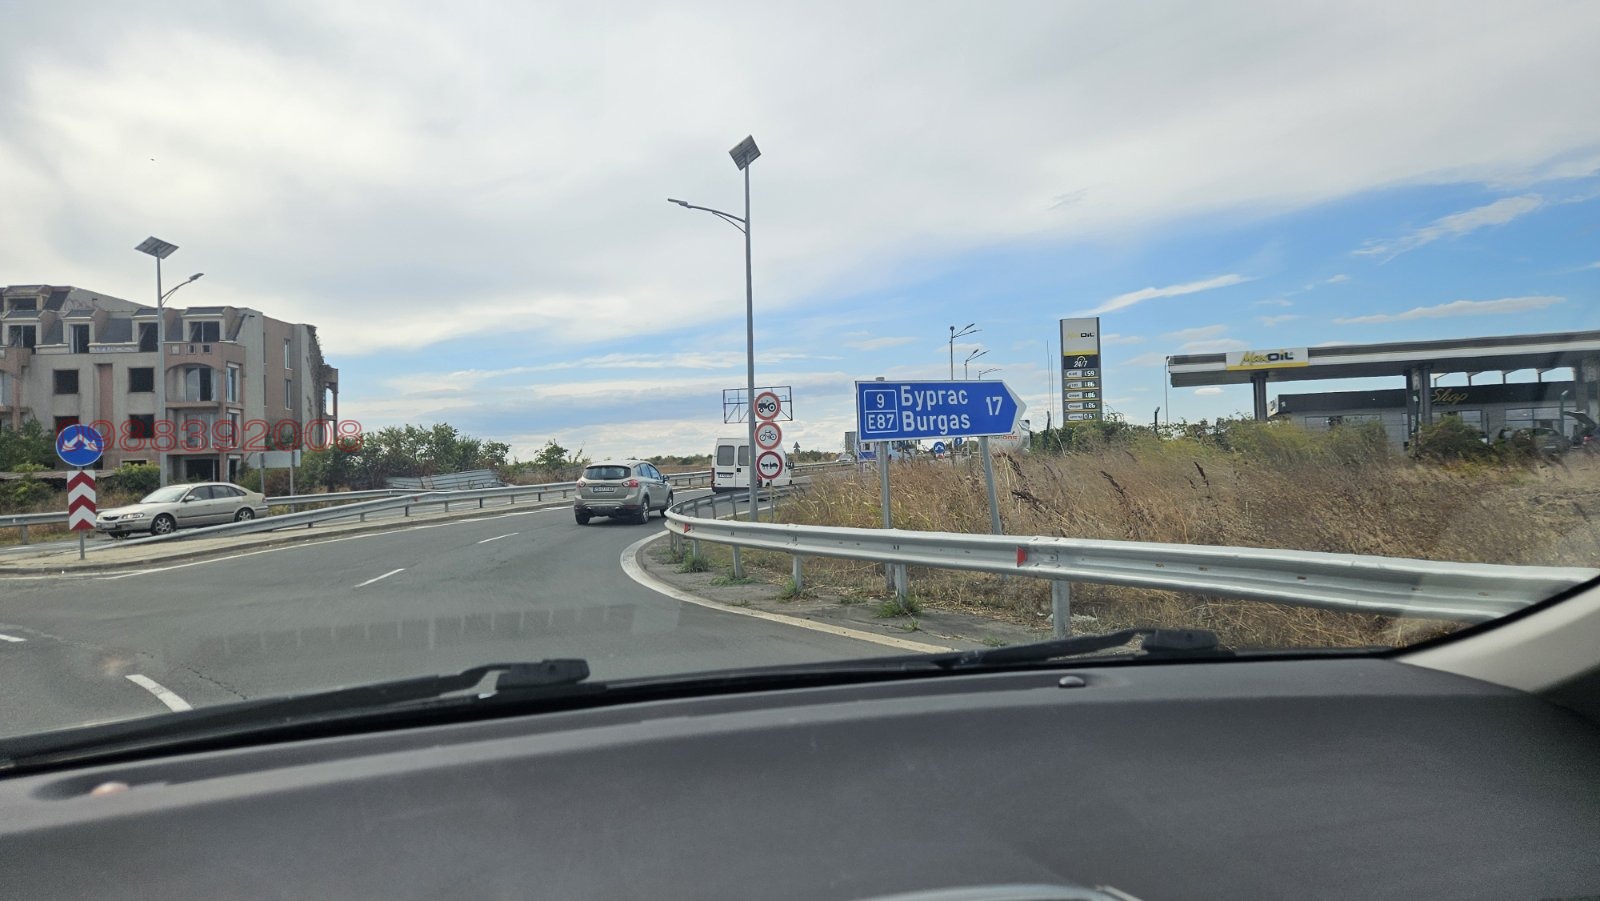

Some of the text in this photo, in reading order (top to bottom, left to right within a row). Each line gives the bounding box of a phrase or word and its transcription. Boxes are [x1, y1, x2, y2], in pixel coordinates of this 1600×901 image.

[876, 393, 885, 409] 9
[900, 386, 969, 411] Бургас
[1432, 388, 1469, 405] Shop
[985, 396, 1003, 416] 17
[868, 414, 895, 430] E87
[902, 411, 971, 435] Burgas
